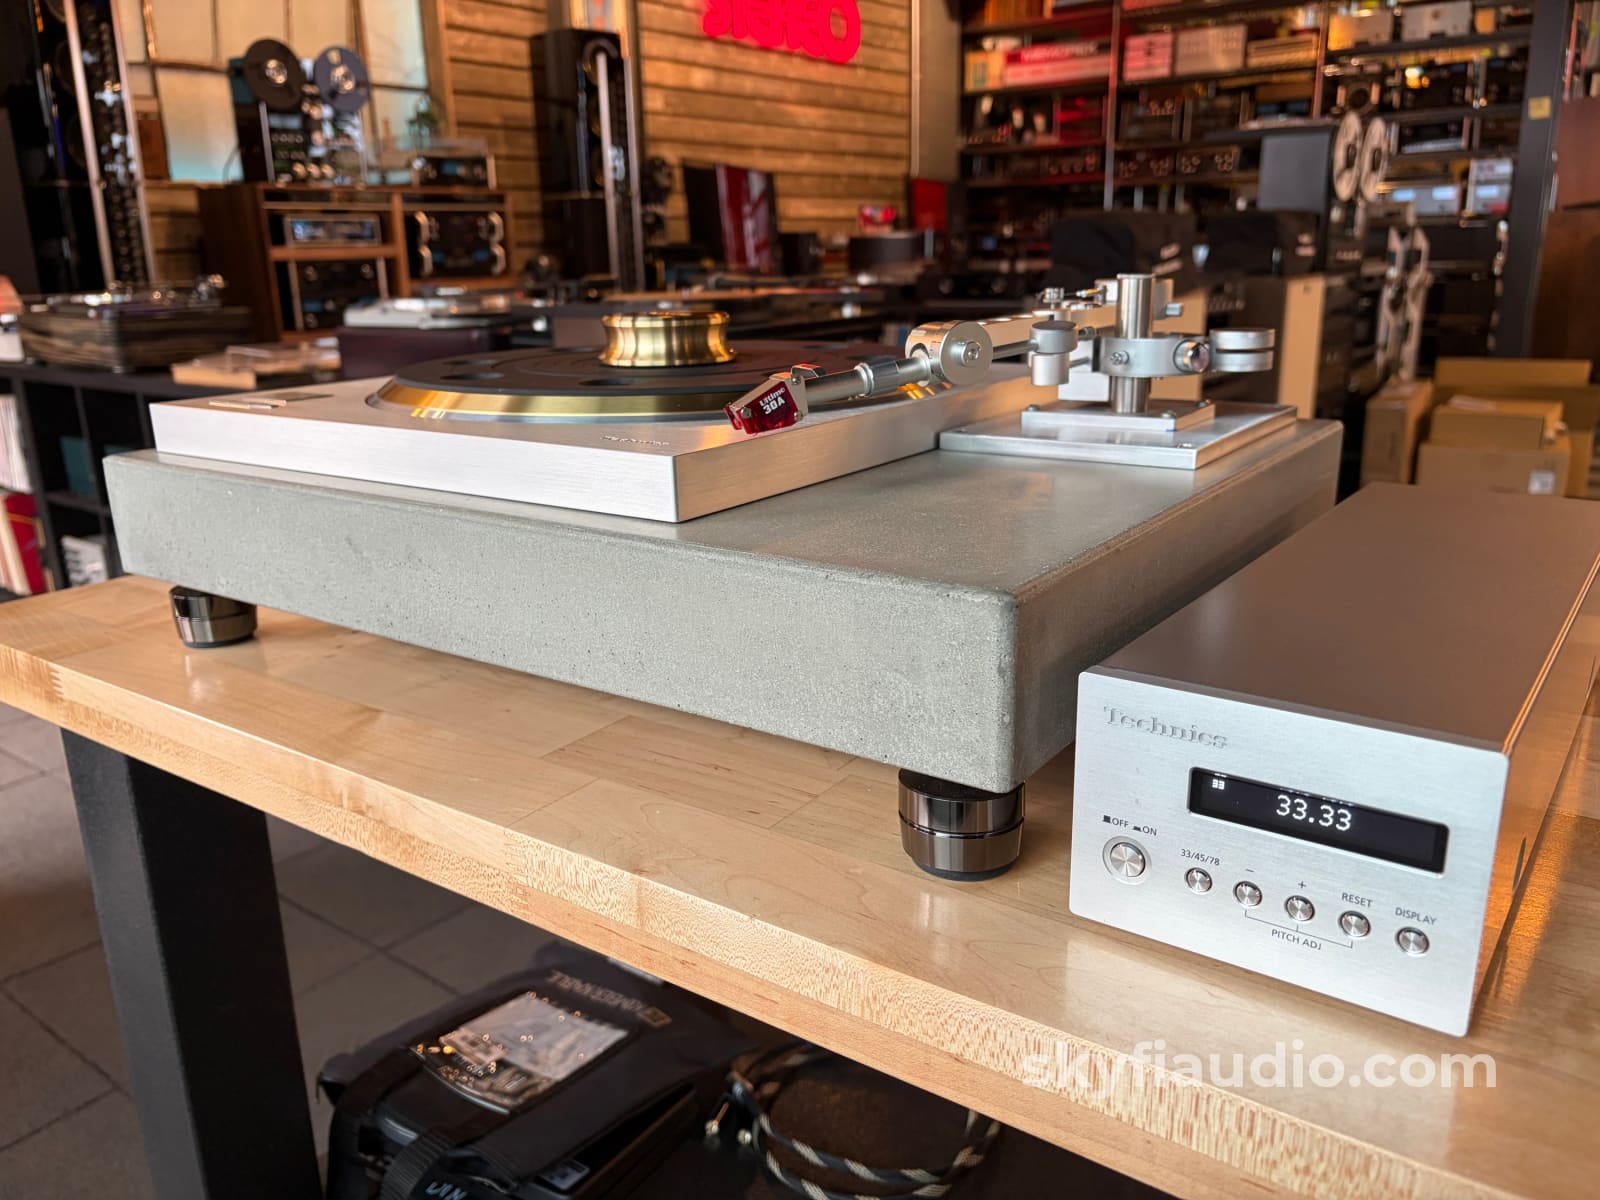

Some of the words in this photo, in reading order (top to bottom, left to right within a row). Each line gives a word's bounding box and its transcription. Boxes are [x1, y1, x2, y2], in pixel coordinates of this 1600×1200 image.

[763, 396, 786, 415] 30A
[1103, 705, 1228, 749] Technics
[1276, 794, 1352, 831] 33.33
[1112, 817, 1129, 829] OFF
[1142, 825, 1157, 837] ON
[1180, 848, 1220, 867] 33/45/78
[1341, 892, 1373, 908] RESET
[1395, 907, 1438, 926] DISPLAY
[1271, 928, 1300, 945] PITCH
[1302, 938, 1322, 951] ADJ
